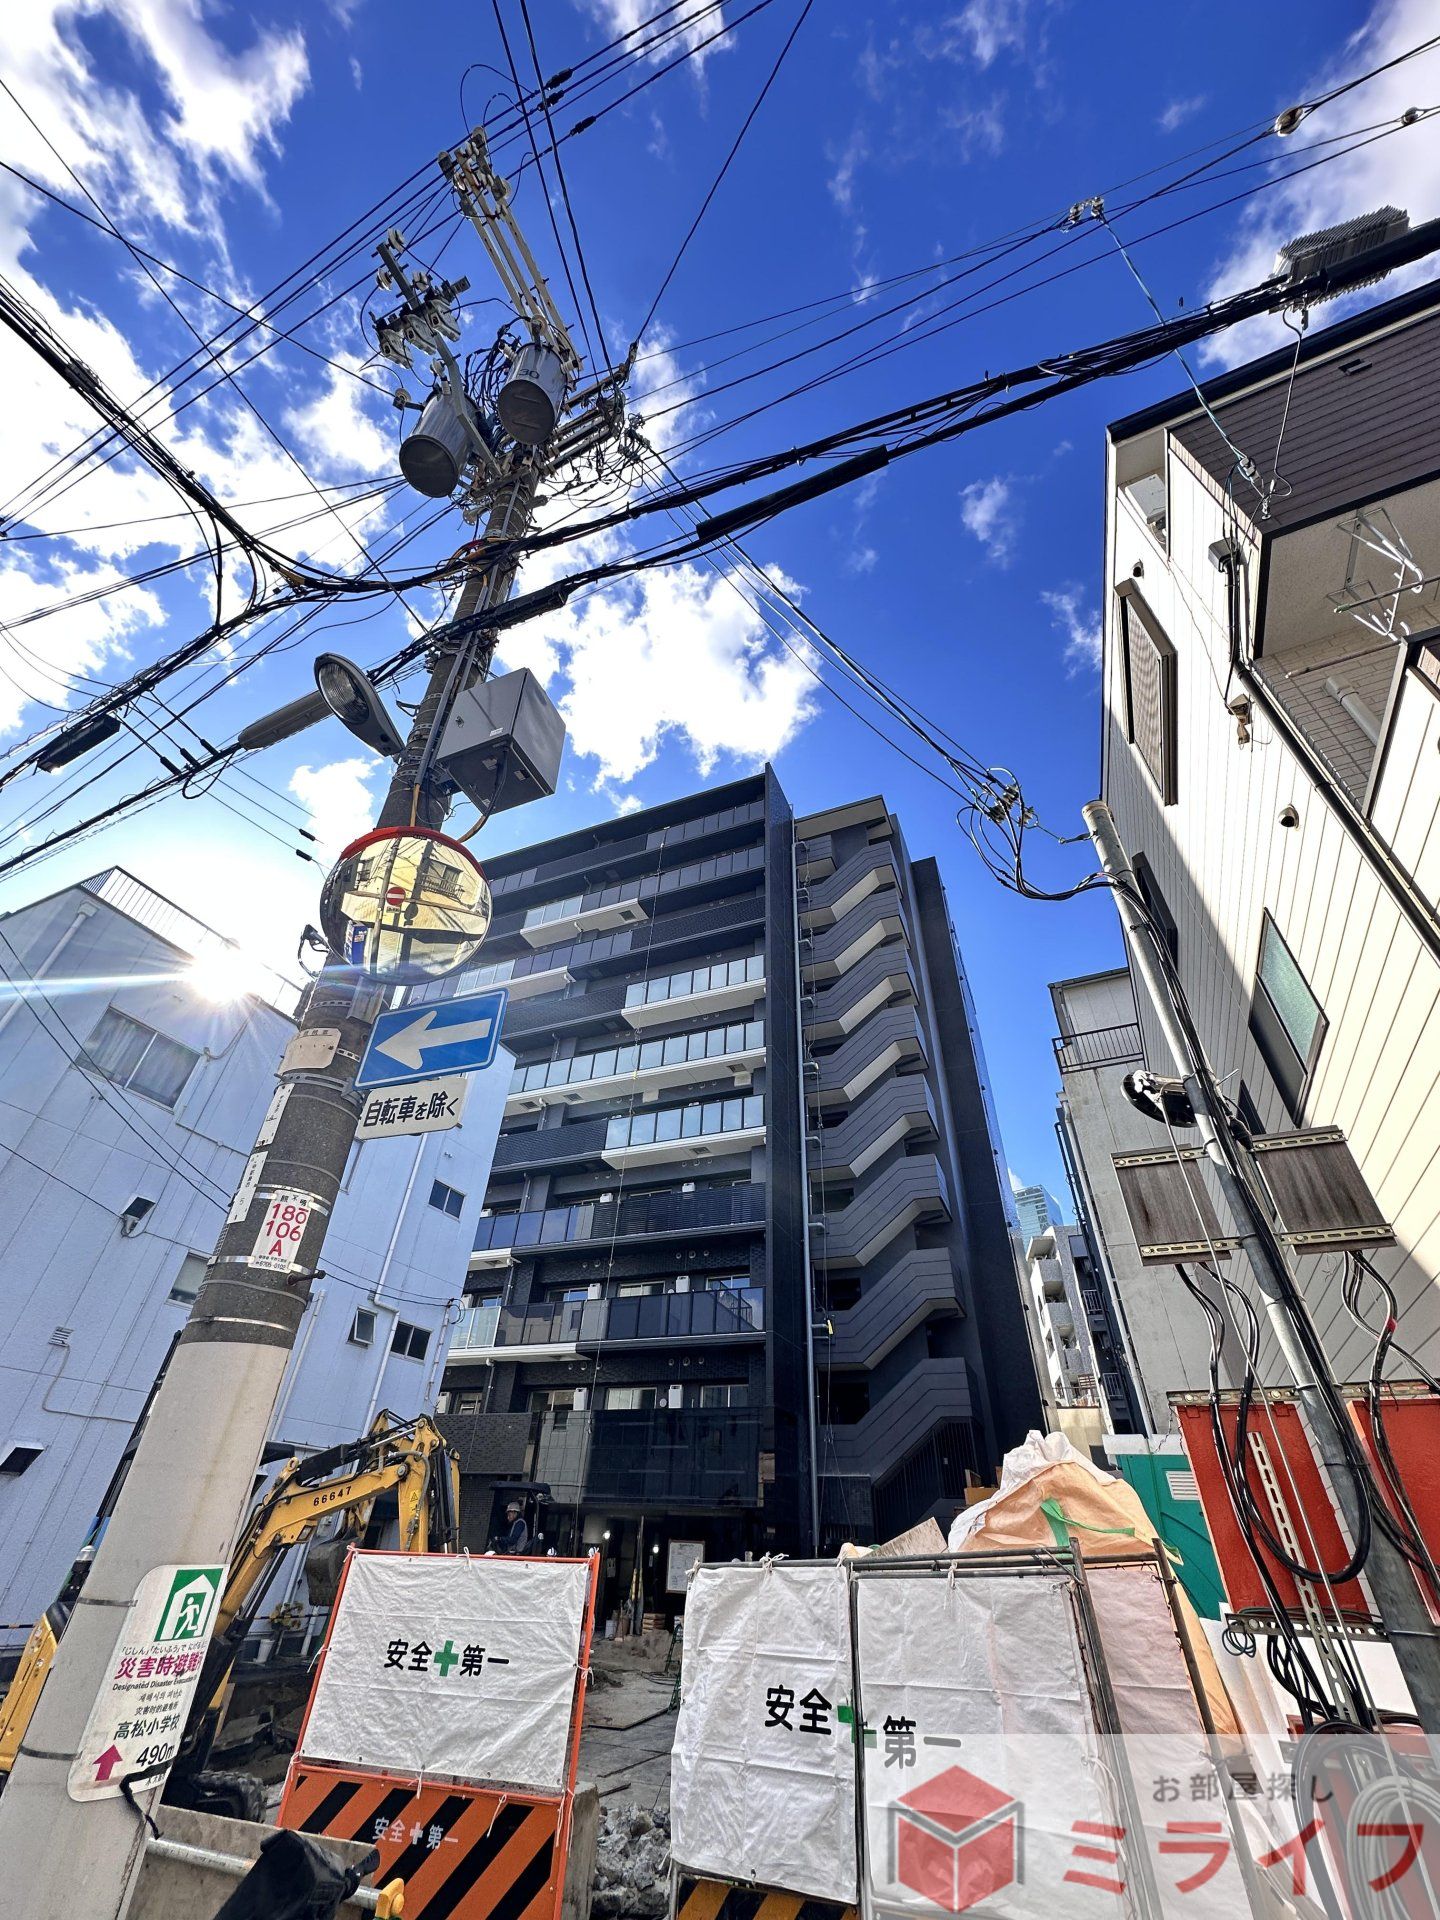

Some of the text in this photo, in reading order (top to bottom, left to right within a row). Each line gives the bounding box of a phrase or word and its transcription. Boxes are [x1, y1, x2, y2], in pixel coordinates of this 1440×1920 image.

[519, 369, 540, 379] 30
[363, 1091, 459, 1127] 自転車を除く
[266, 1220, 301, 1241] 106
[268, 1239, 282, 1256] A
[313, 1486, 351, 1506] 66647
[383, 1638, 510, 1677] 安全 第一
[112, 1680, 149, 1691] Designated
[150, 1679, 173, 1688] Disaster
[114, 1714, 180, 1741] 高松小学校
[764, 1684, 962, 1770] 安全 第一
[136, 1742, 175, 1767] 490m
[372, 1816, 459, 1850] 安全 第一
